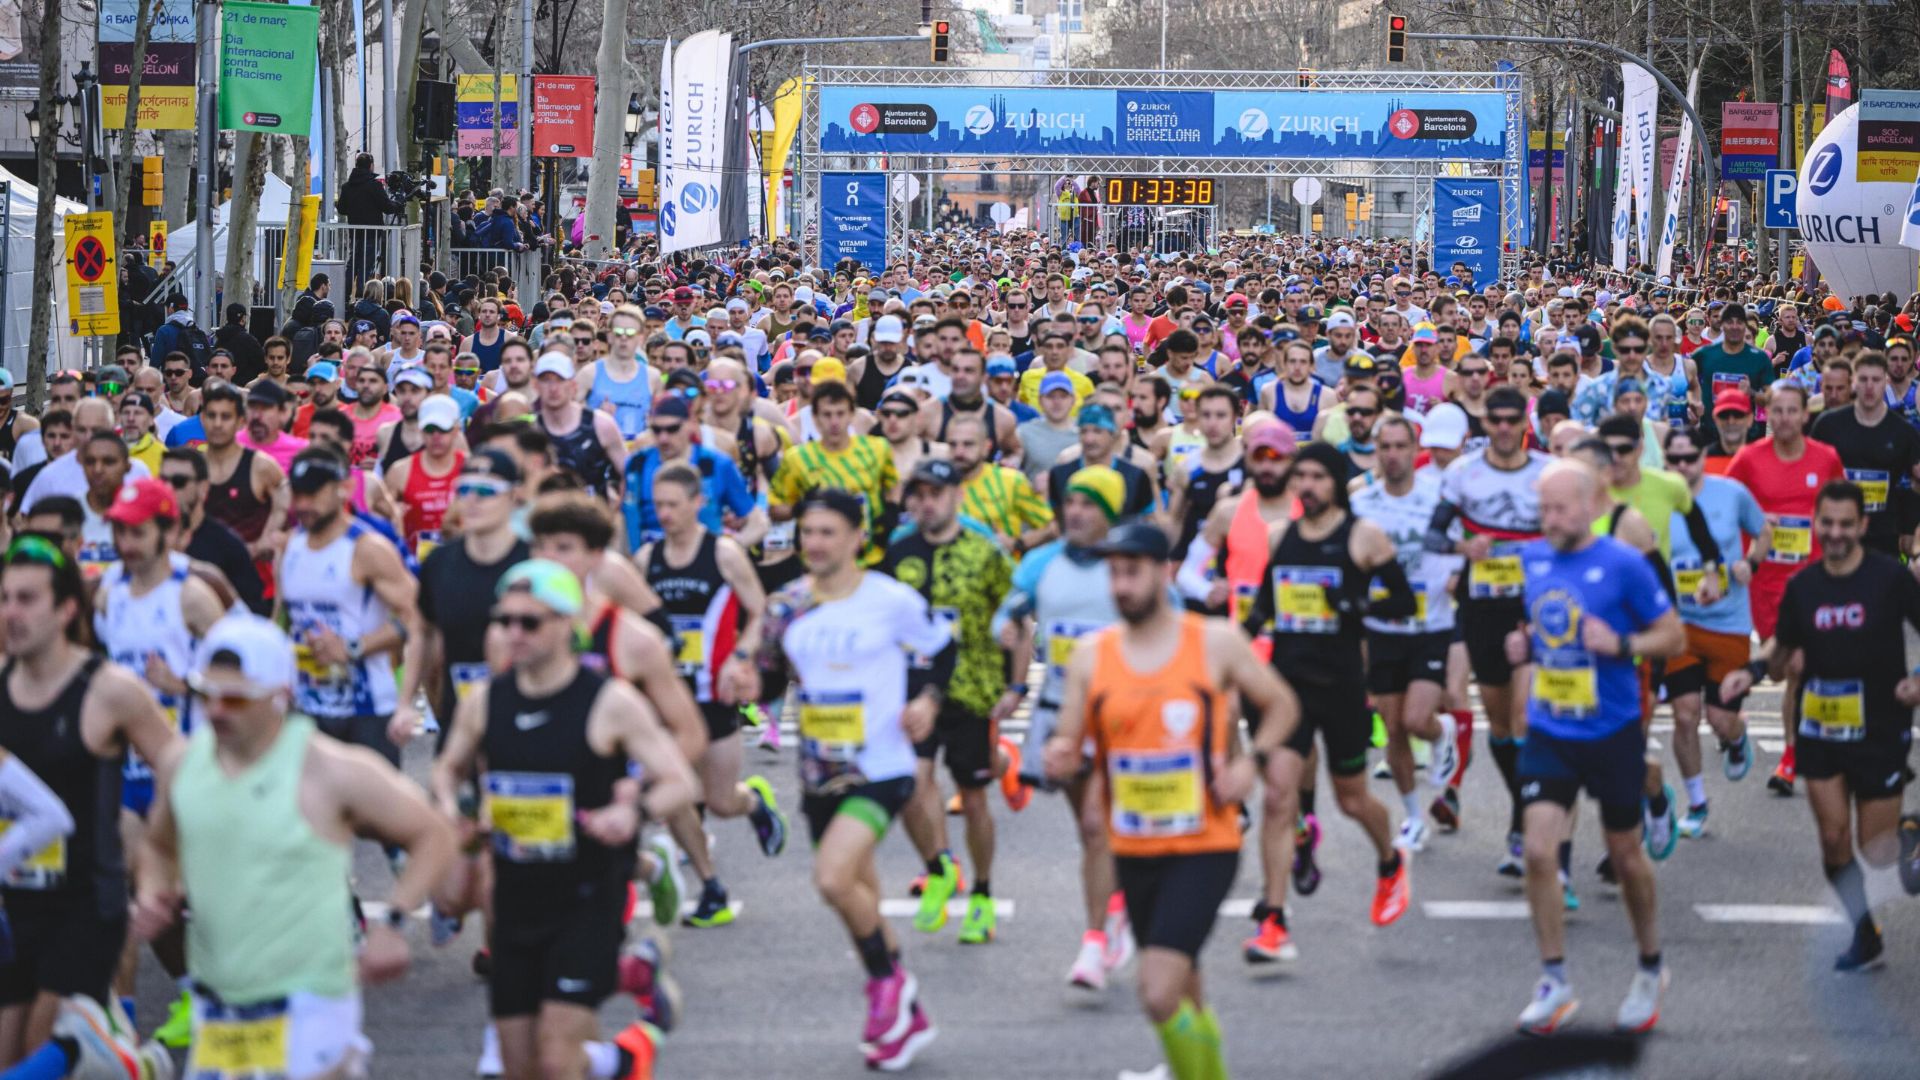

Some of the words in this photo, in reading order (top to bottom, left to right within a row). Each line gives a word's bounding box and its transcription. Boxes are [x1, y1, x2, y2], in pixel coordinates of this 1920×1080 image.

[106, 15, 113, 24] Я
[227, 12, 239, 22] 21
[243, 14, 257, 24] de
[260, 16, 287, 28] març
[225, 34, 243, 45] Dia
[224, 46, 294, 60] Internacional
[223, 58, 258, 68] contra
[223, 68, 232, 77] el
[235, 68, 282, 81] Racisme
[557, 83, 576, 91] març
[537, 95, 549, 103] Dia
[1141, 103, 1170, 111] ZURICH
[885, 110, 918, 118] Ajuntament
[1004, 112, 1085, 128] ZURICH
[1127, 112, 1178, 128] MARATÓ
[544, 117, 575, 125] Racisme
[687, 83, 704, 170] ZURICH
[884, 118, 927, 126] Barcelona
[1279, 115, 1360, 132] ZURICH
[1424, 123, 1467, 131] Barcelona
[1126, 128, 1201, 142] BARCELONA
[1109, 180, 1211, 203] 01:33:38
[1774, 174, 1797, 204] P
[1729, 206, 1737, 233] P
